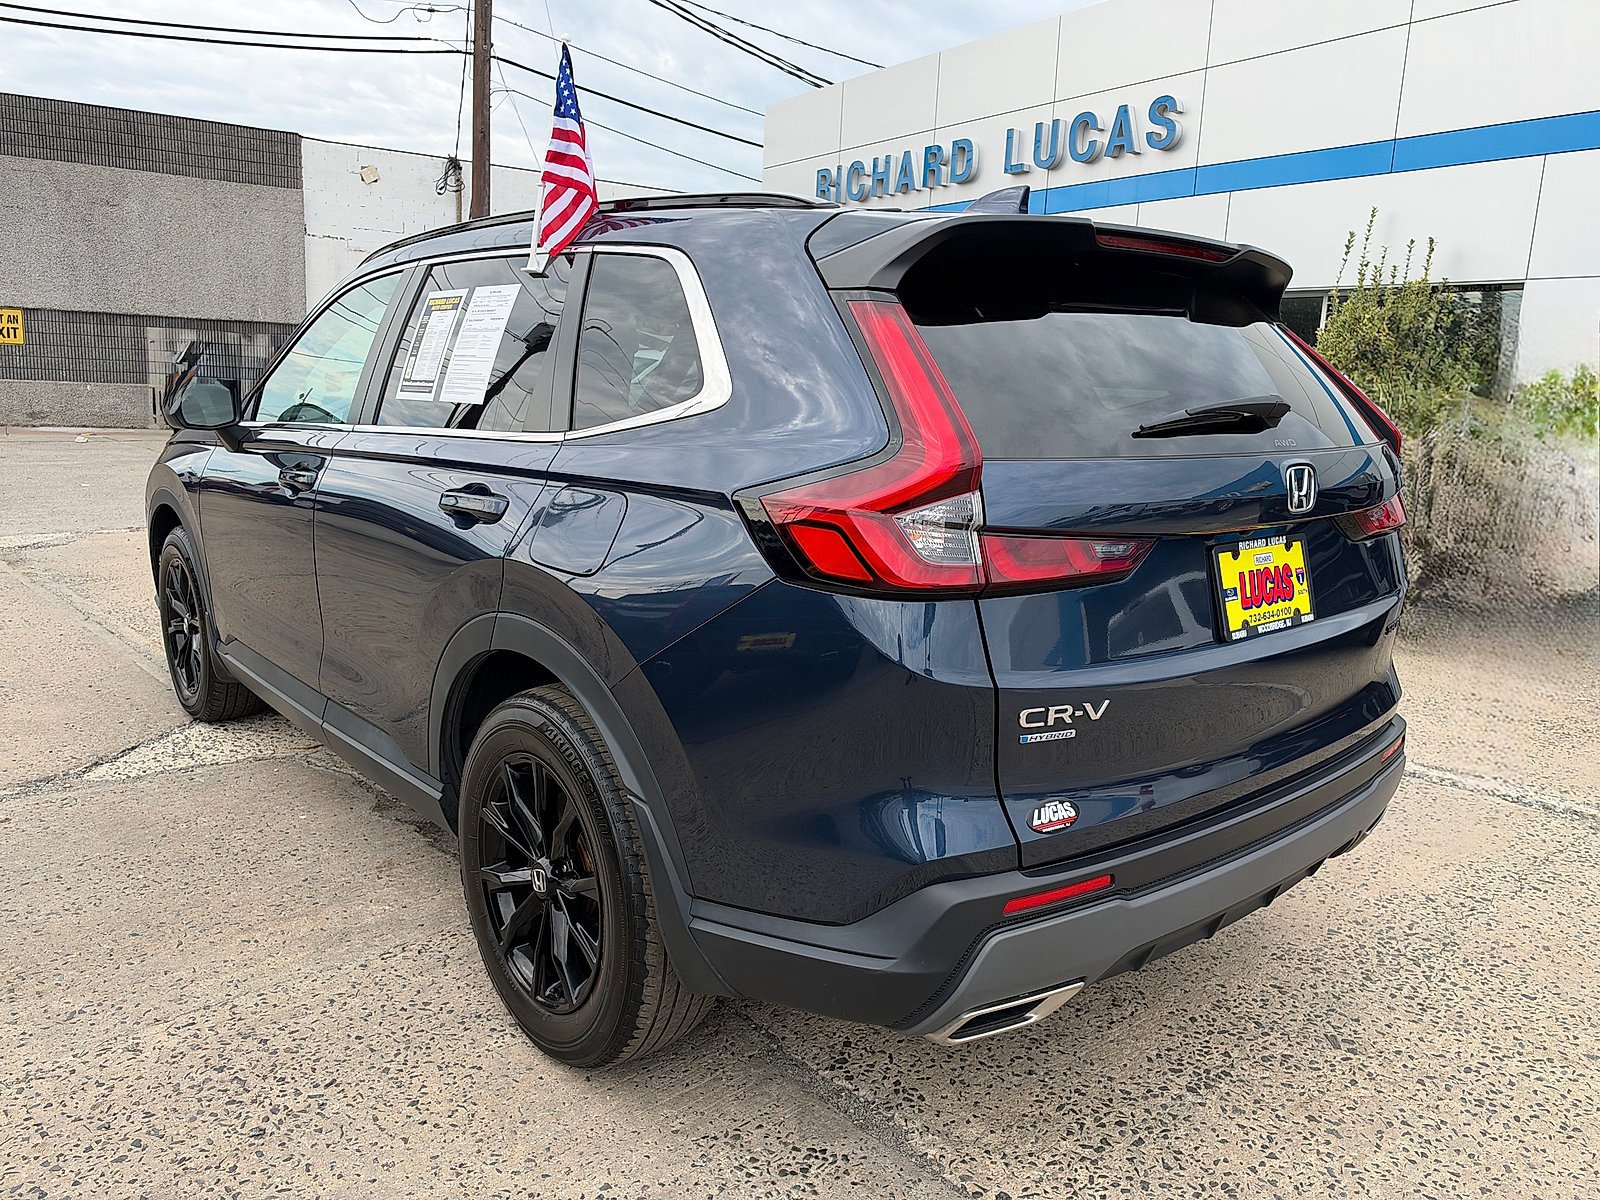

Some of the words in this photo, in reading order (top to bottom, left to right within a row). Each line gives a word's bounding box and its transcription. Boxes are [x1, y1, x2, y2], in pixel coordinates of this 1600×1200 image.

[816, 138, 979, 204] RICHARD
[1004, 95, 1184, 175] LUCAS
[7, 315, 19, 324] AN
[1274, 438, 1297, 447] AWD
[1239, 538, 1266, 550] RICHARD
[1267, 535, 1286, 546] LUCAS
[1255, 554, 1272, 564] RICHARD
[1239, 563, 1295, 610] LUCAS
[1249, 606, 1292, 623] 732-634-0100
[1019, 699, 1111, 728] CR-V
[1029, 731, 1073, 741] HYBRID
[544, 725, 614, 848] BRIDGESTONE
[1032, 801, 1076, 826] LUCAS
